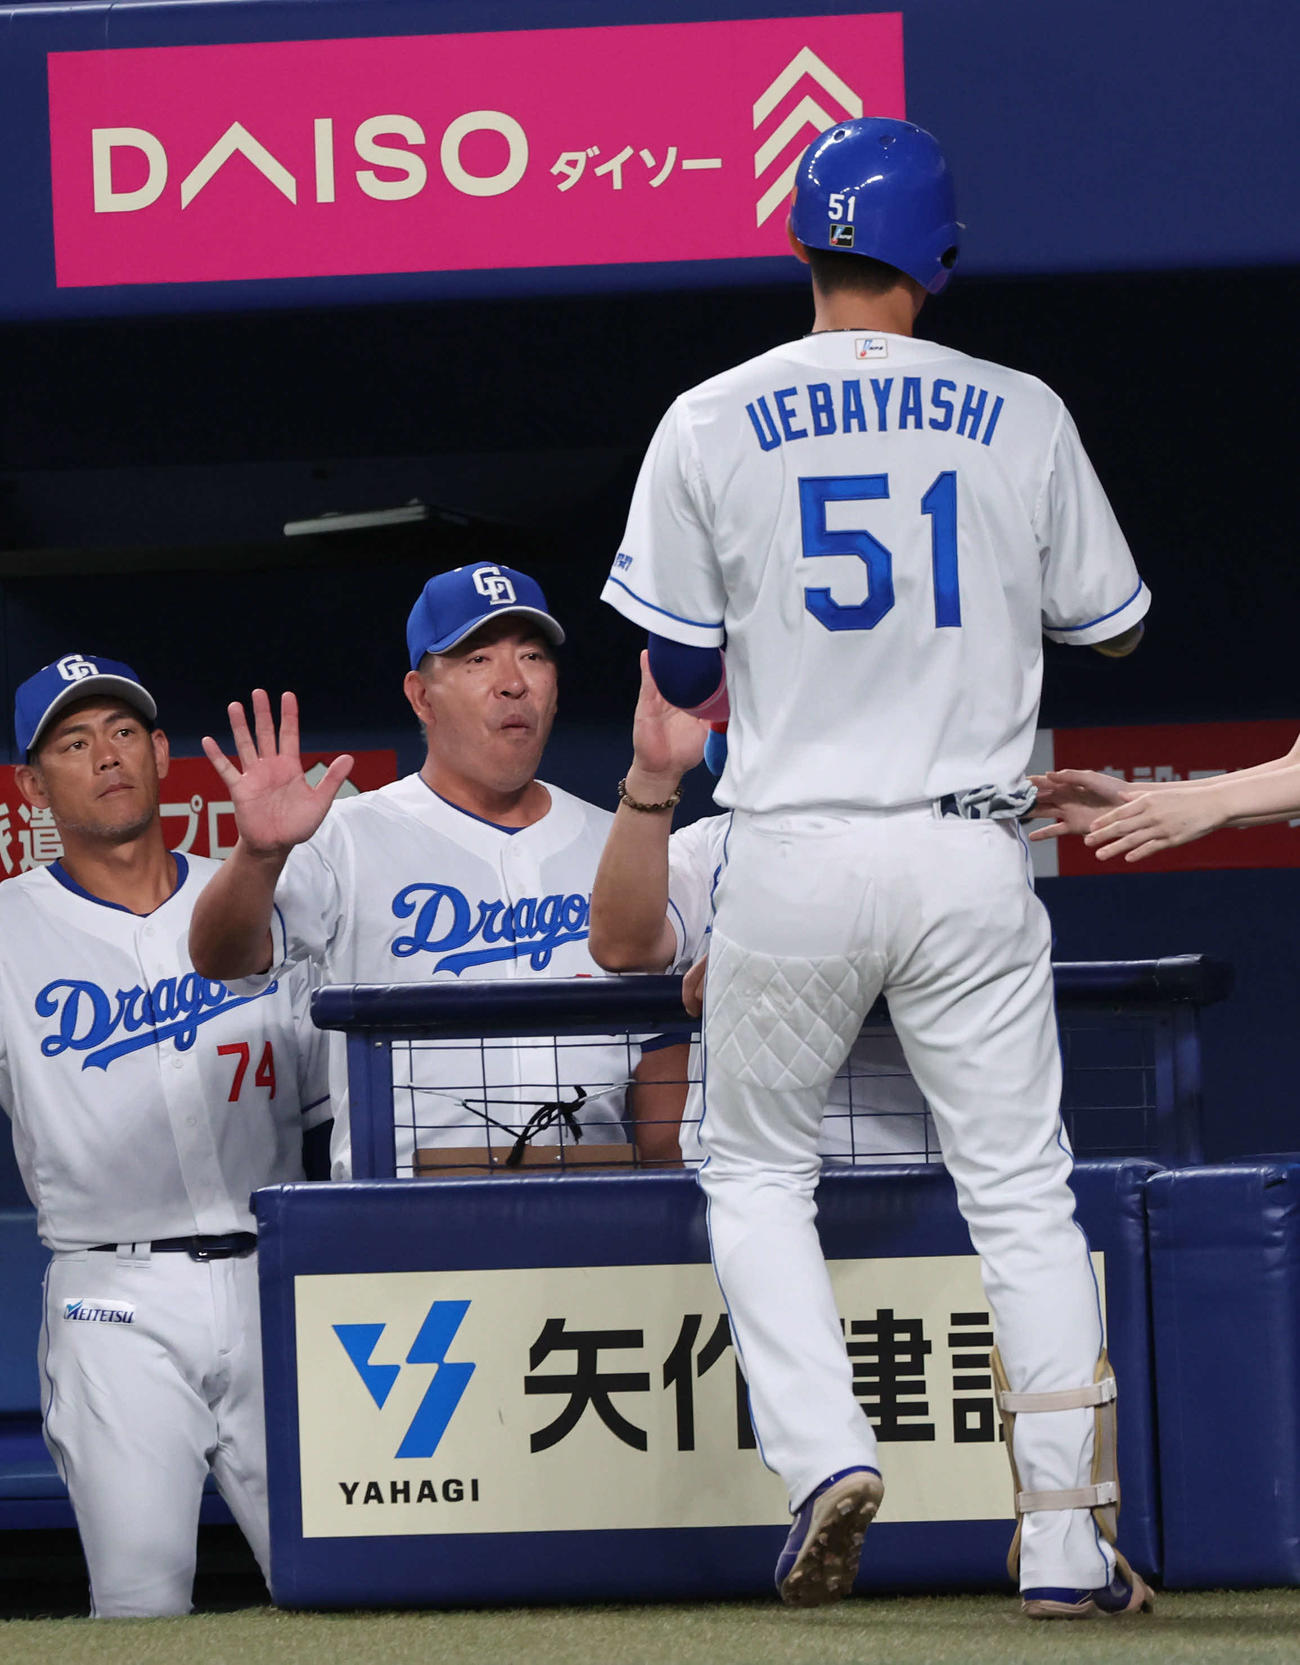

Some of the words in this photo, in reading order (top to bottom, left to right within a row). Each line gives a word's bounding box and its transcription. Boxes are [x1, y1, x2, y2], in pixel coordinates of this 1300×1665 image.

[92, 110, 529, 213] DAISO
[549, 145, 722, 192] ダイソー
[828, 193, 856, 222] 51
[745, 377, 1004, 452] UEBAYASHI
[798, 470, 962, 631] 51
[391, 882, 592, 977] Drago
[35, 972, 279, 1072] Drago
[217, 1041, 277, 1102] 74
[338, 1479, 480, 1505] YAHAGI
